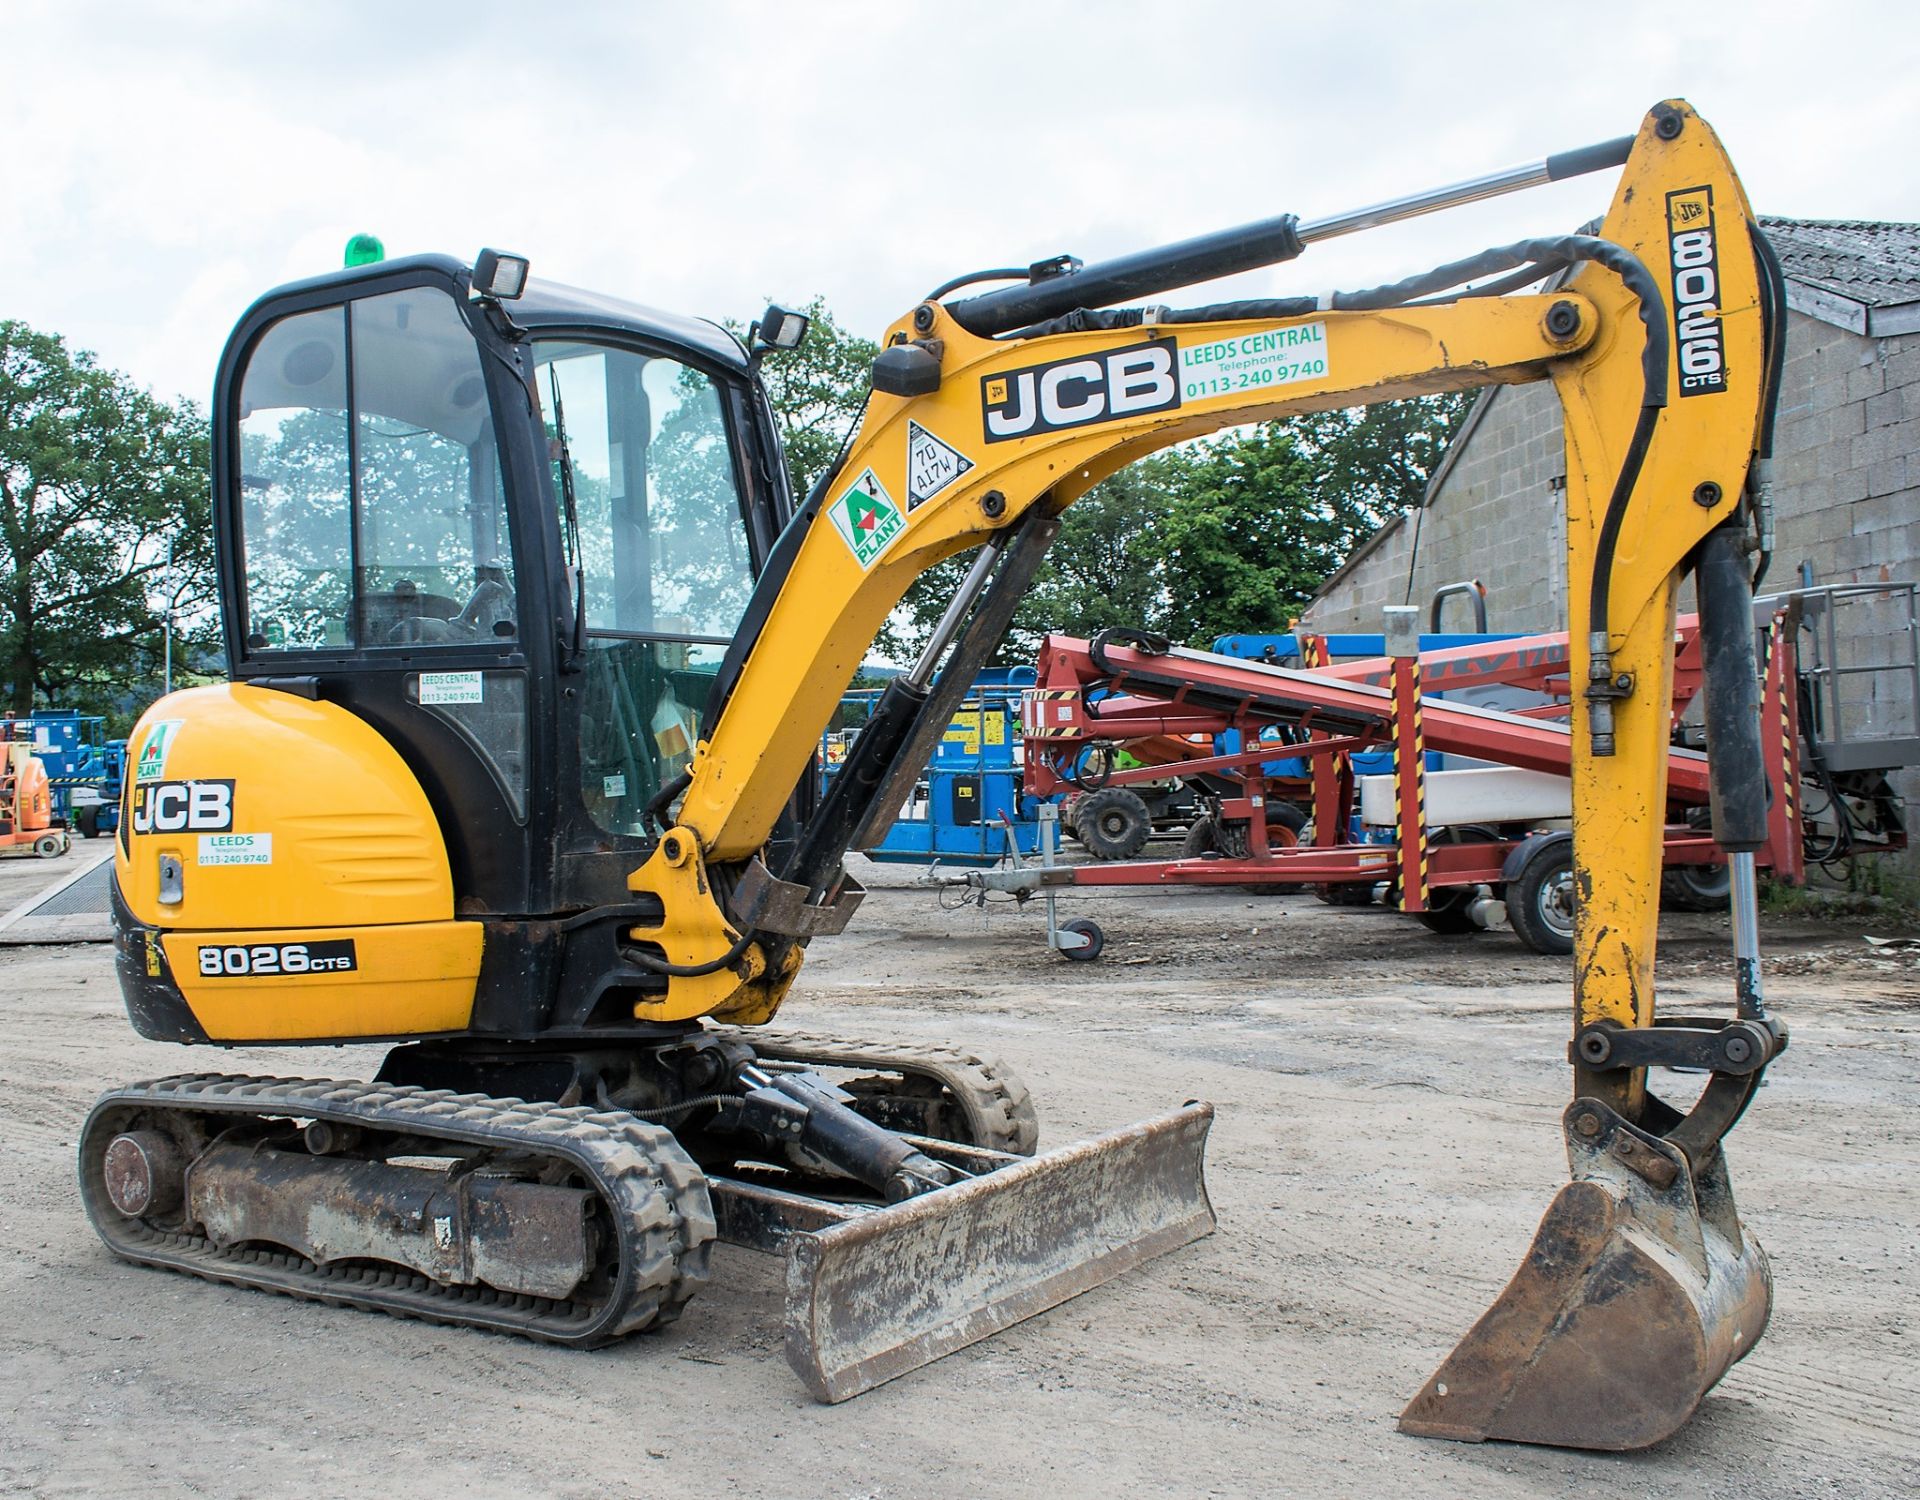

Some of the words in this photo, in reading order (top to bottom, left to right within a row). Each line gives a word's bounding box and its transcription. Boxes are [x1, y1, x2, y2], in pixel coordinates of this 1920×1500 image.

[1681, 203, 1703, 221] JCB
[1673, 231, 1721, 375] 8026
[1184, 341, 1236, 367] LEEDS
[1241, 325, 1322, 354] CENTRAL
[1218, 352, 1288, 372] Telephone:
[1186, 369, 1272, 397] 0113-240
[1277, 359, 1324, 380] 9740
[1683, 373, 1722, 388] CTS
[987, 346, 1176, 436] JCB
[857, 512, 901, 564] PLANT
[1515, 644, 1566, 669] 170
[422, 675, 444, 685] LEEDS
[445, 673, 479, 684] CENTRAL
[421, 693, 458, 702] 0113-240
[459, 692, 480, 701] 9740
[138, 763, 162, 776] PLANT
[134, 783, 231, 831] JCB
[210, 836, 254, 847] LEEDS
[199, 855, 241, 864] 0113-240
[243, 855, 268, 863] 9740
[199, 945, 310, 974] 8026
[310, 957, 352, 971] CTS
